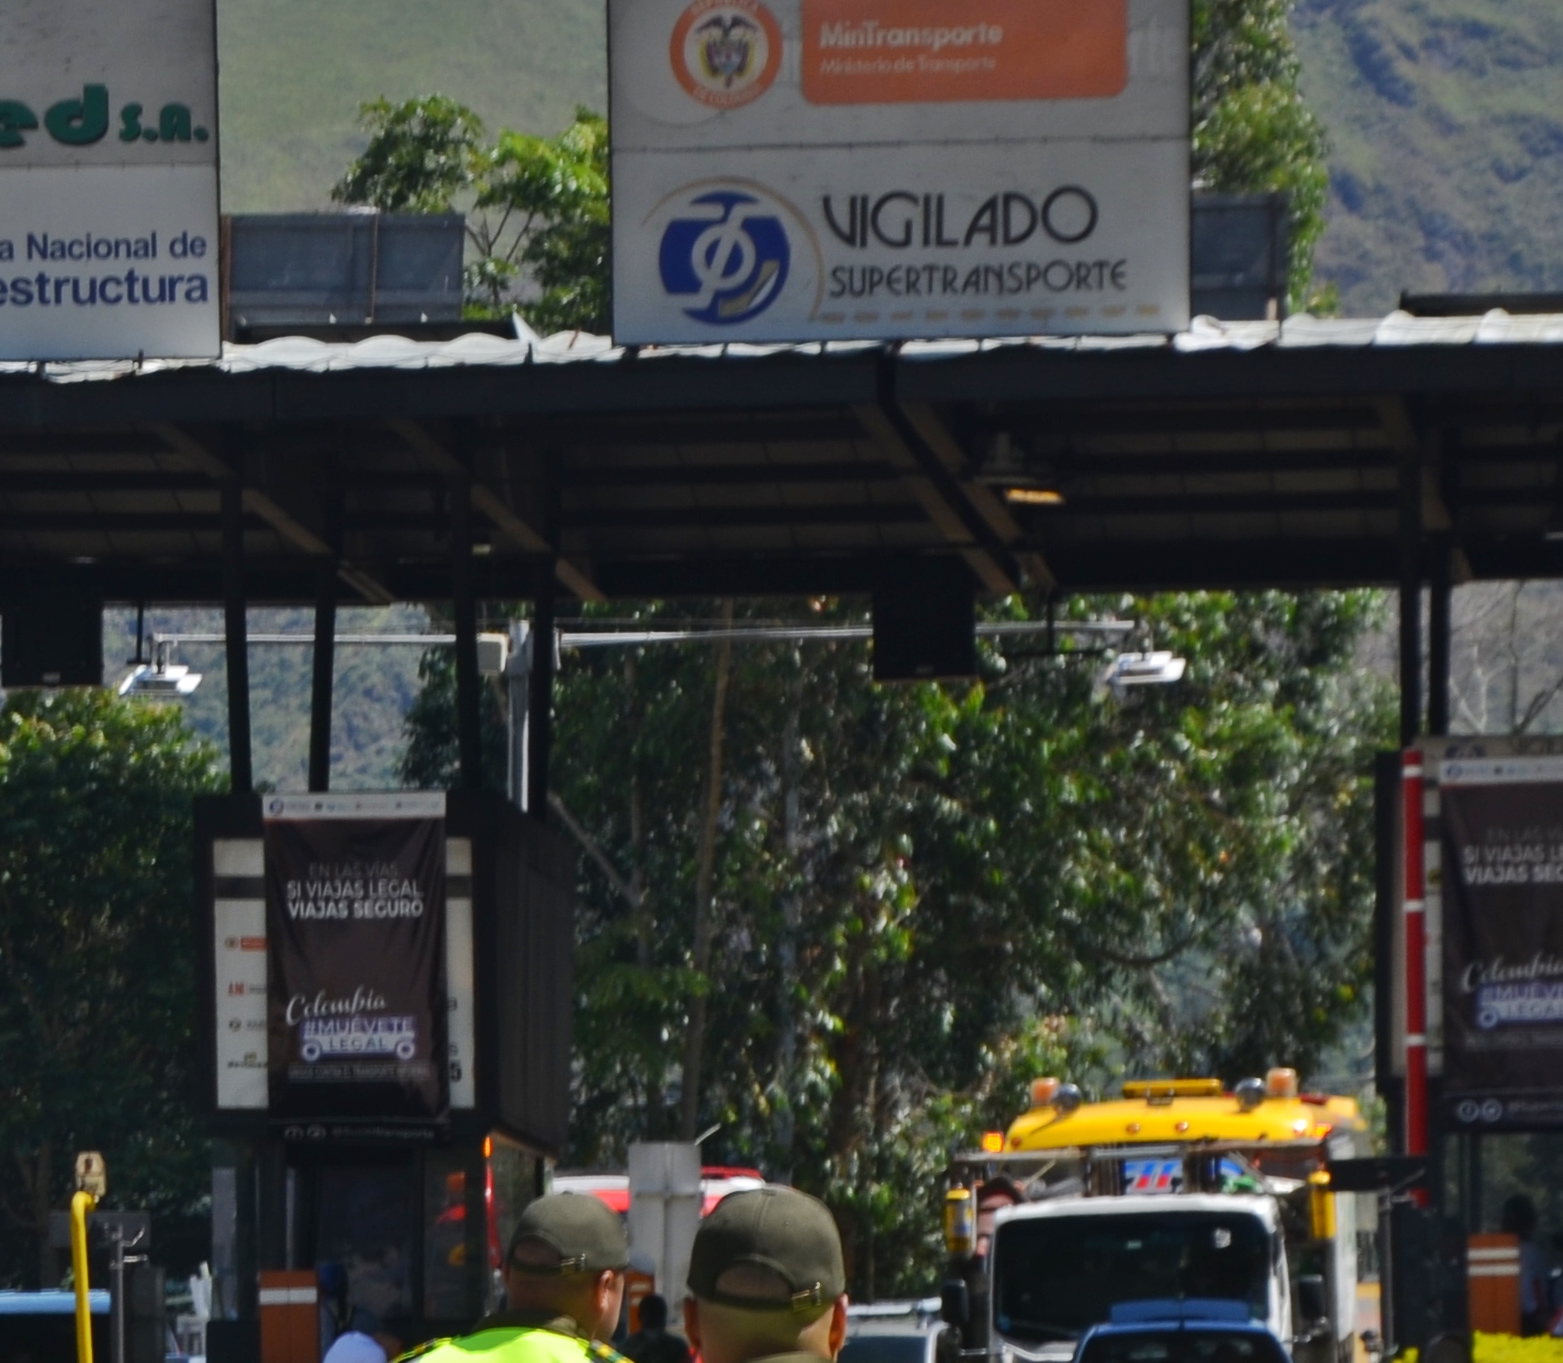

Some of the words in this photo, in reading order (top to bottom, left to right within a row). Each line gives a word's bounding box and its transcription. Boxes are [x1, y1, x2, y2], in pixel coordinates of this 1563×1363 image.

[819, 20, 1003, 51] MinTransporte
[820, 185, 1099, 249] VIGILADO
[27, 230, 158, 262] Nacional
[169, 230, 208, 259] de
[829, 258, 1128, 299] SUPERTRANSPORTE
[287, 879, 302, 899] SI
[305, 878, 365, 899] VIAJAS
[288, 899, 349, 919] VIAJAS
[352, 898, 424, 919] SEGURO
[285, 983, 388, 1027] Colombia
